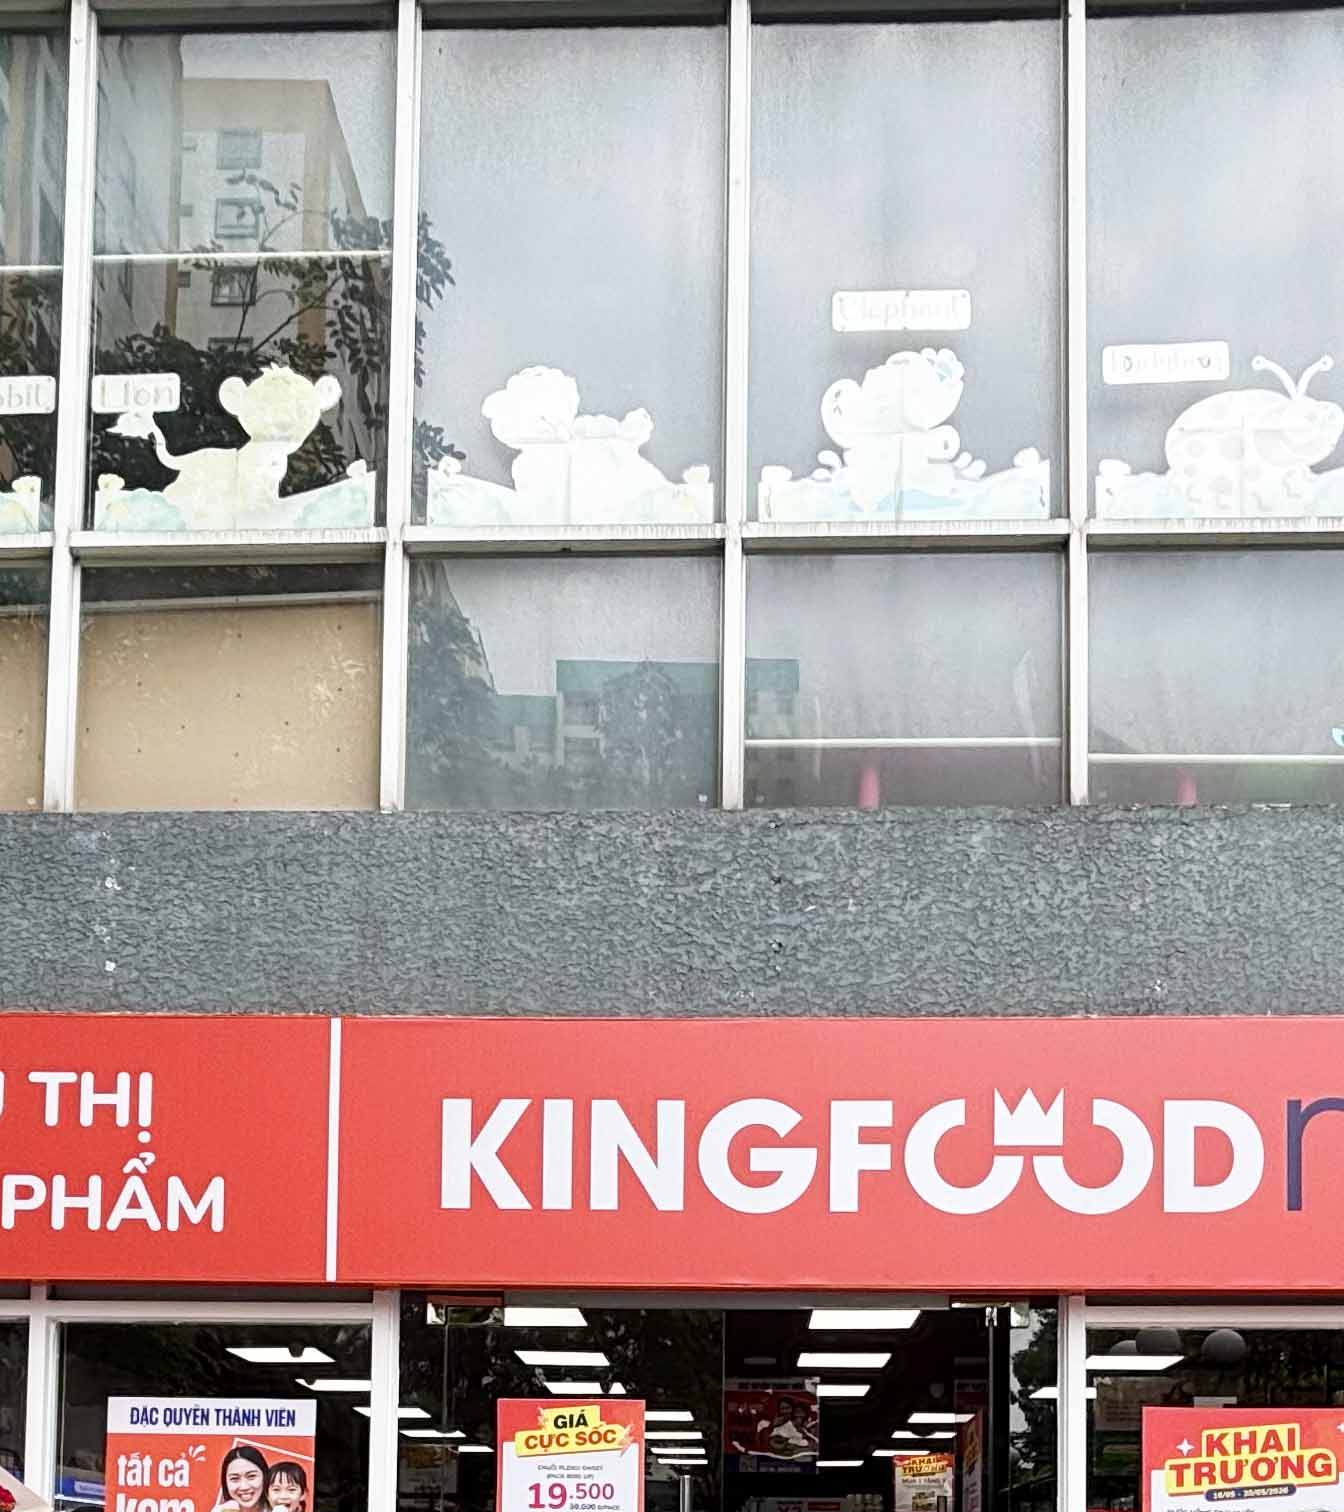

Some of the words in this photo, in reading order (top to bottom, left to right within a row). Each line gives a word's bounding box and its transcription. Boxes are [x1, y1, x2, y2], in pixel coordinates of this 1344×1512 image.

[28, 1071, 154, 1144] THỊ
[0, 1152, 226, 1233] PHẨM
[214, 1406, 260, 1427] THÀNH
[553, 1409, 589, 1429] GIÁ
[524, 1432, 570, 1453] CỰC
[574, 1425, 618, 1448] SỐC
[1205, 1427, 1297, 1458] KHAI
[117, 1453, 153, 1487] tất
[158, 1453, 191, 1487] cả
[1167, 1453, 1334, 1488] TRƯƠNG
[528, 1482, 616, 1510] 19.500
